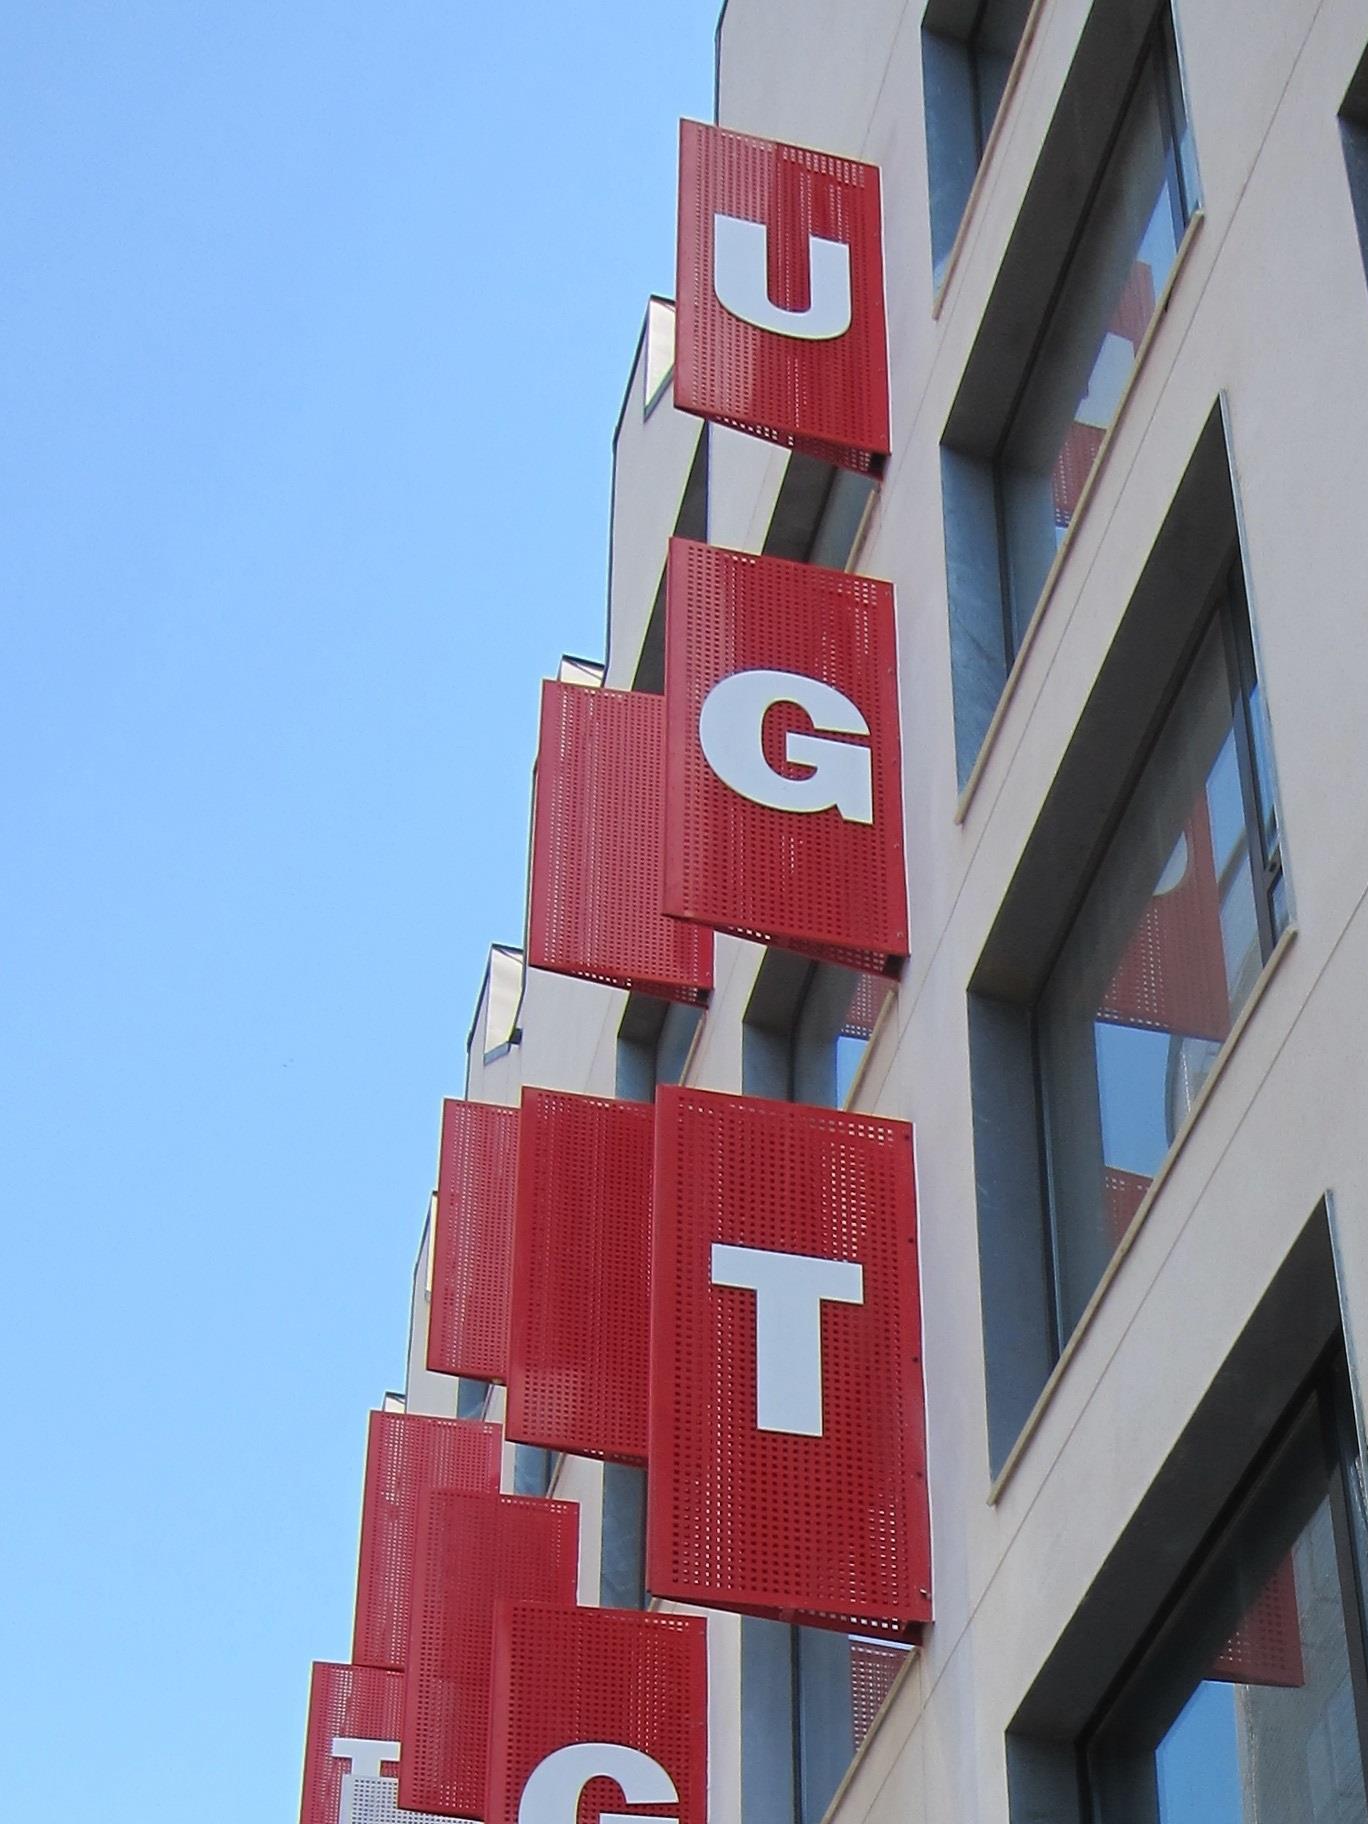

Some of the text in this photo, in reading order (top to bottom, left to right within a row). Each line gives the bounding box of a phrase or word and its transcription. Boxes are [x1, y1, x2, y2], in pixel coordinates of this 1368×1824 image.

[713, 212, 853, 340] U
[698, 669, 874, 825] G
[711, 1243, 864, 1437] T
